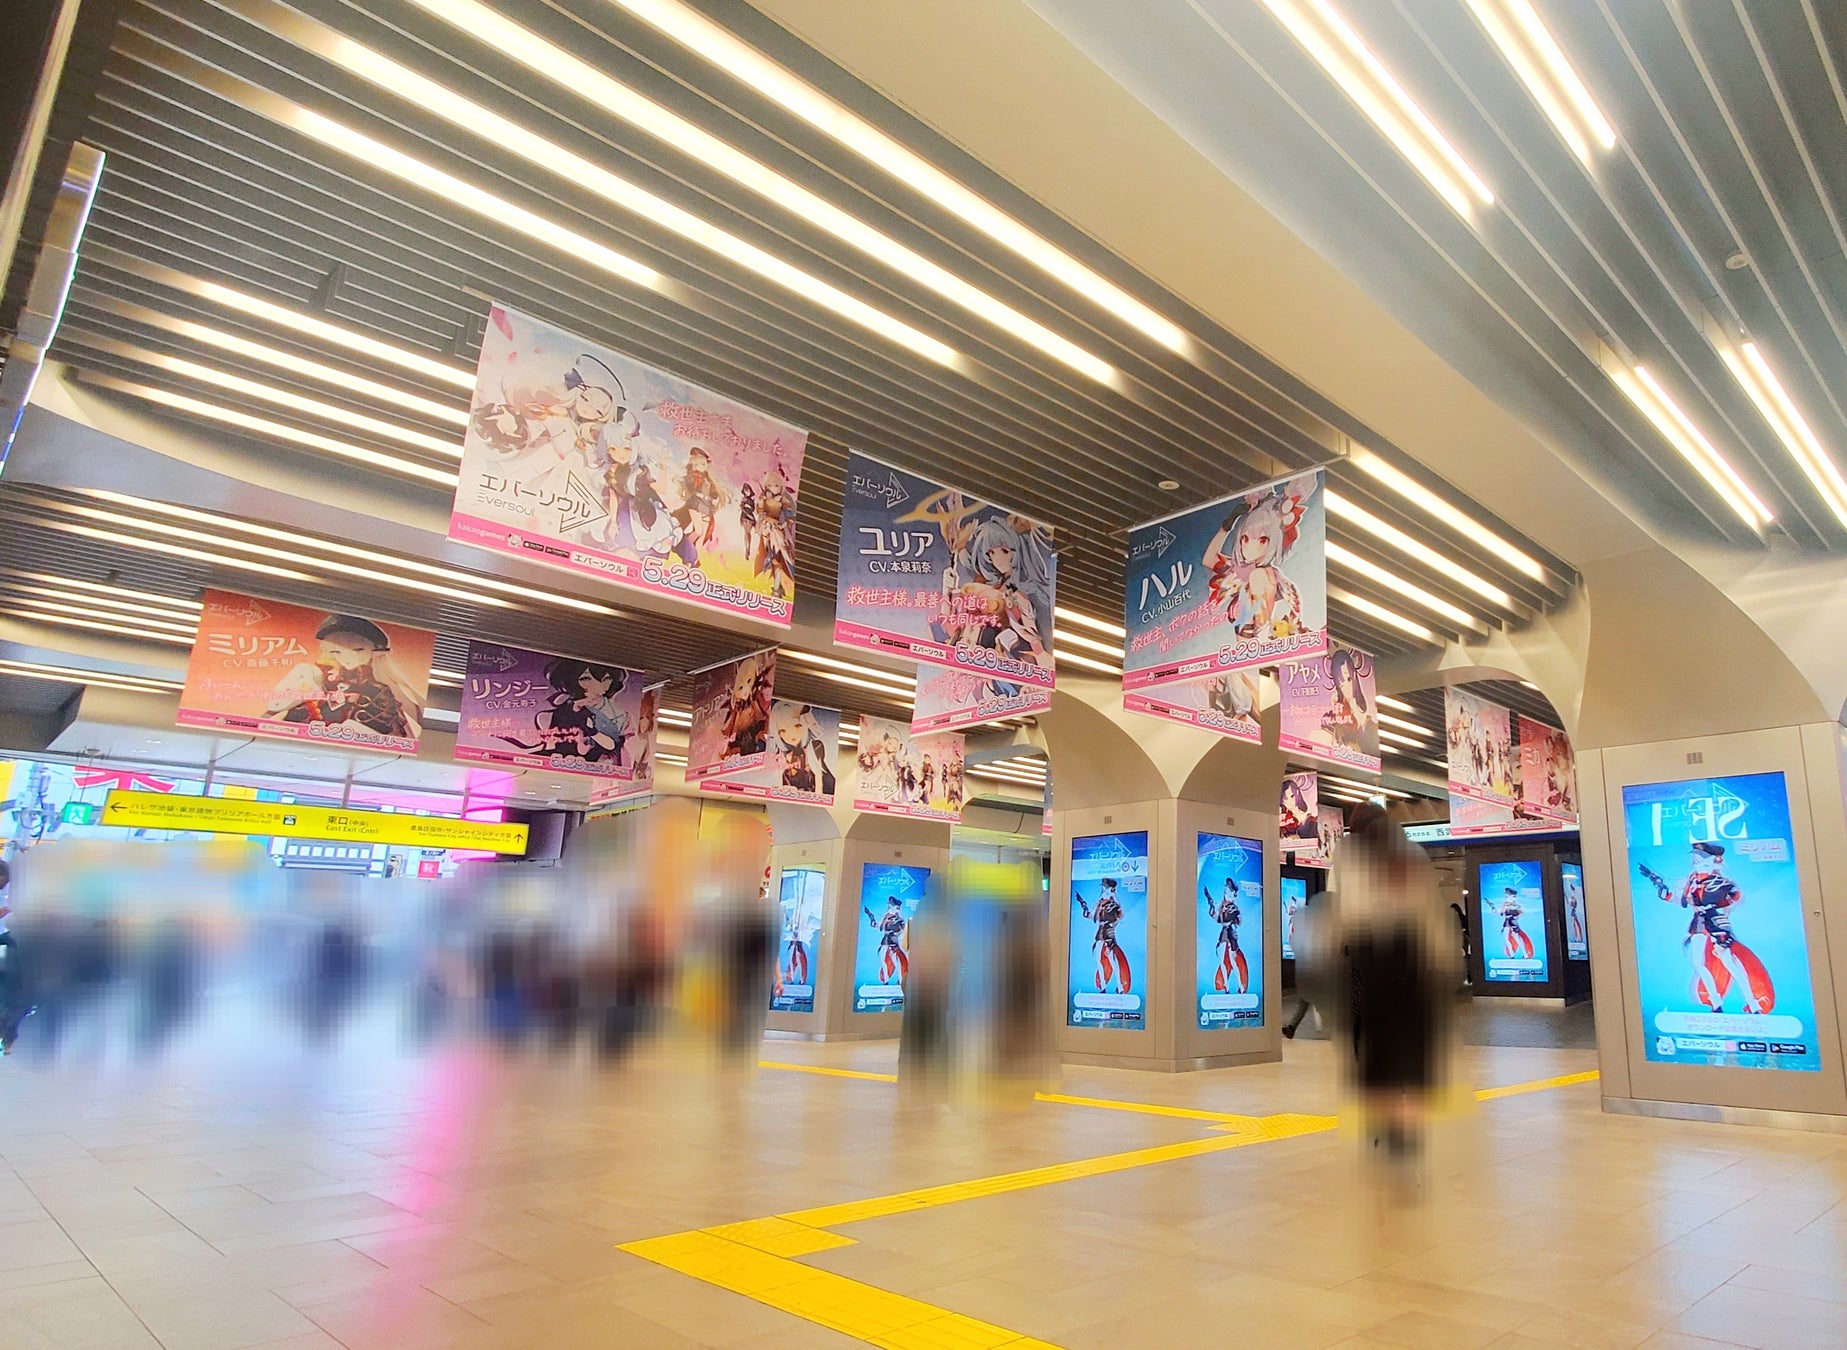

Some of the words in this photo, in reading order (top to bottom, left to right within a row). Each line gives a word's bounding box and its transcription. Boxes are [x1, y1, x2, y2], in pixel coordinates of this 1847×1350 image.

[480, 473, 591, 518] エバーソウル
[853, 475, 902, 500] エバーソウル
[859, 527, 934, 557] ユリア
[1132, 537, 1170, 555] エバーソウル
[575, 554, 624, 573] エバーソウル
[1139, 561, 1192, 610] ハル
[847, 587, 989, 610] 救世主様。最善への道は
[209, 603, 263, 619] エバーソウル
[927, 614, 1002, 627] いつも同じです。
[208, 633, 308, 656] ミリアム
[912, 645, 945, 658] エバーソウル
[1180, 662, 1209, 672] エバーソウル
[1285, 661, 1321, 685] アヤメ
[472, 679, 549, 699] リンジー
[1681, 1040, 1720, 1049] エバーソウル
